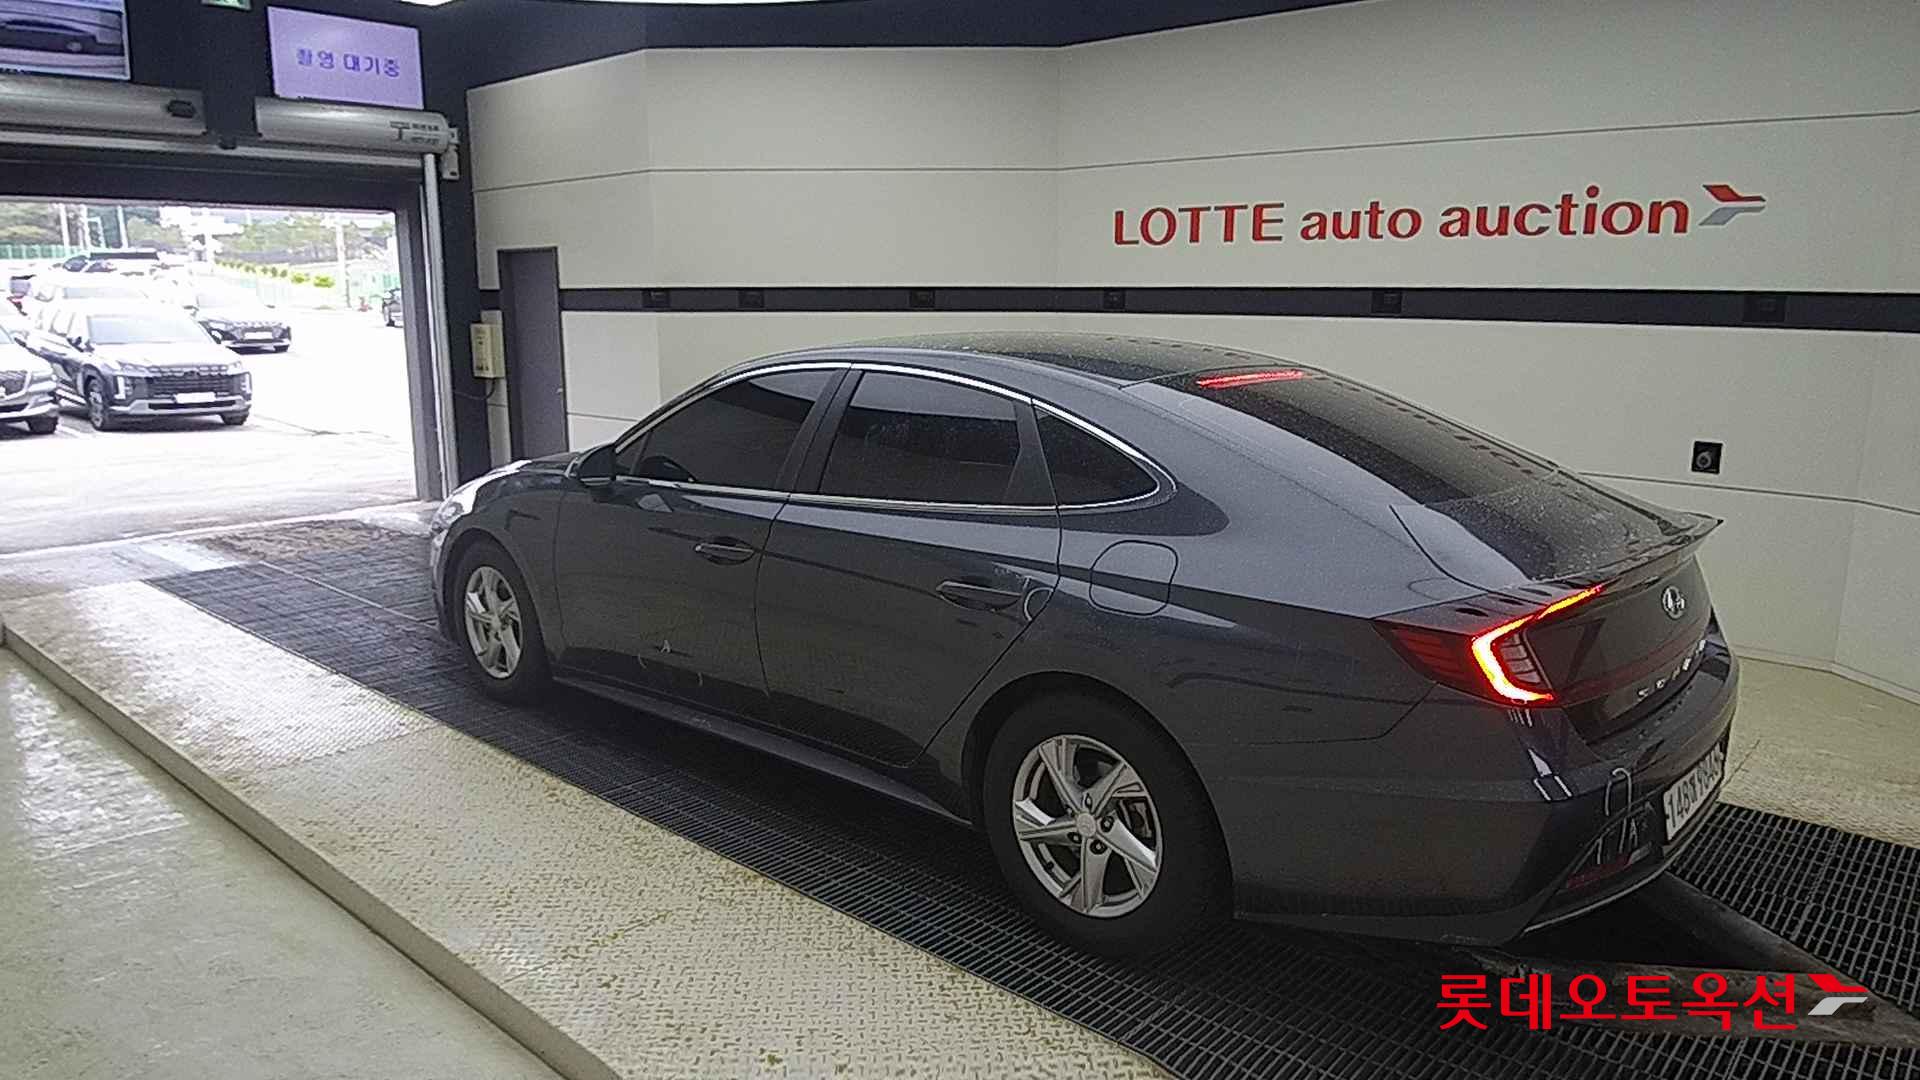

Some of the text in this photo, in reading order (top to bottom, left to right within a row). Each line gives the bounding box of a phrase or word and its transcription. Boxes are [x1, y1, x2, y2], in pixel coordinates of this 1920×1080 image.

[297, 49, 400, 78] 촬영 대기중
[1113, 184, 1690, 246] LOTTE auto auction
